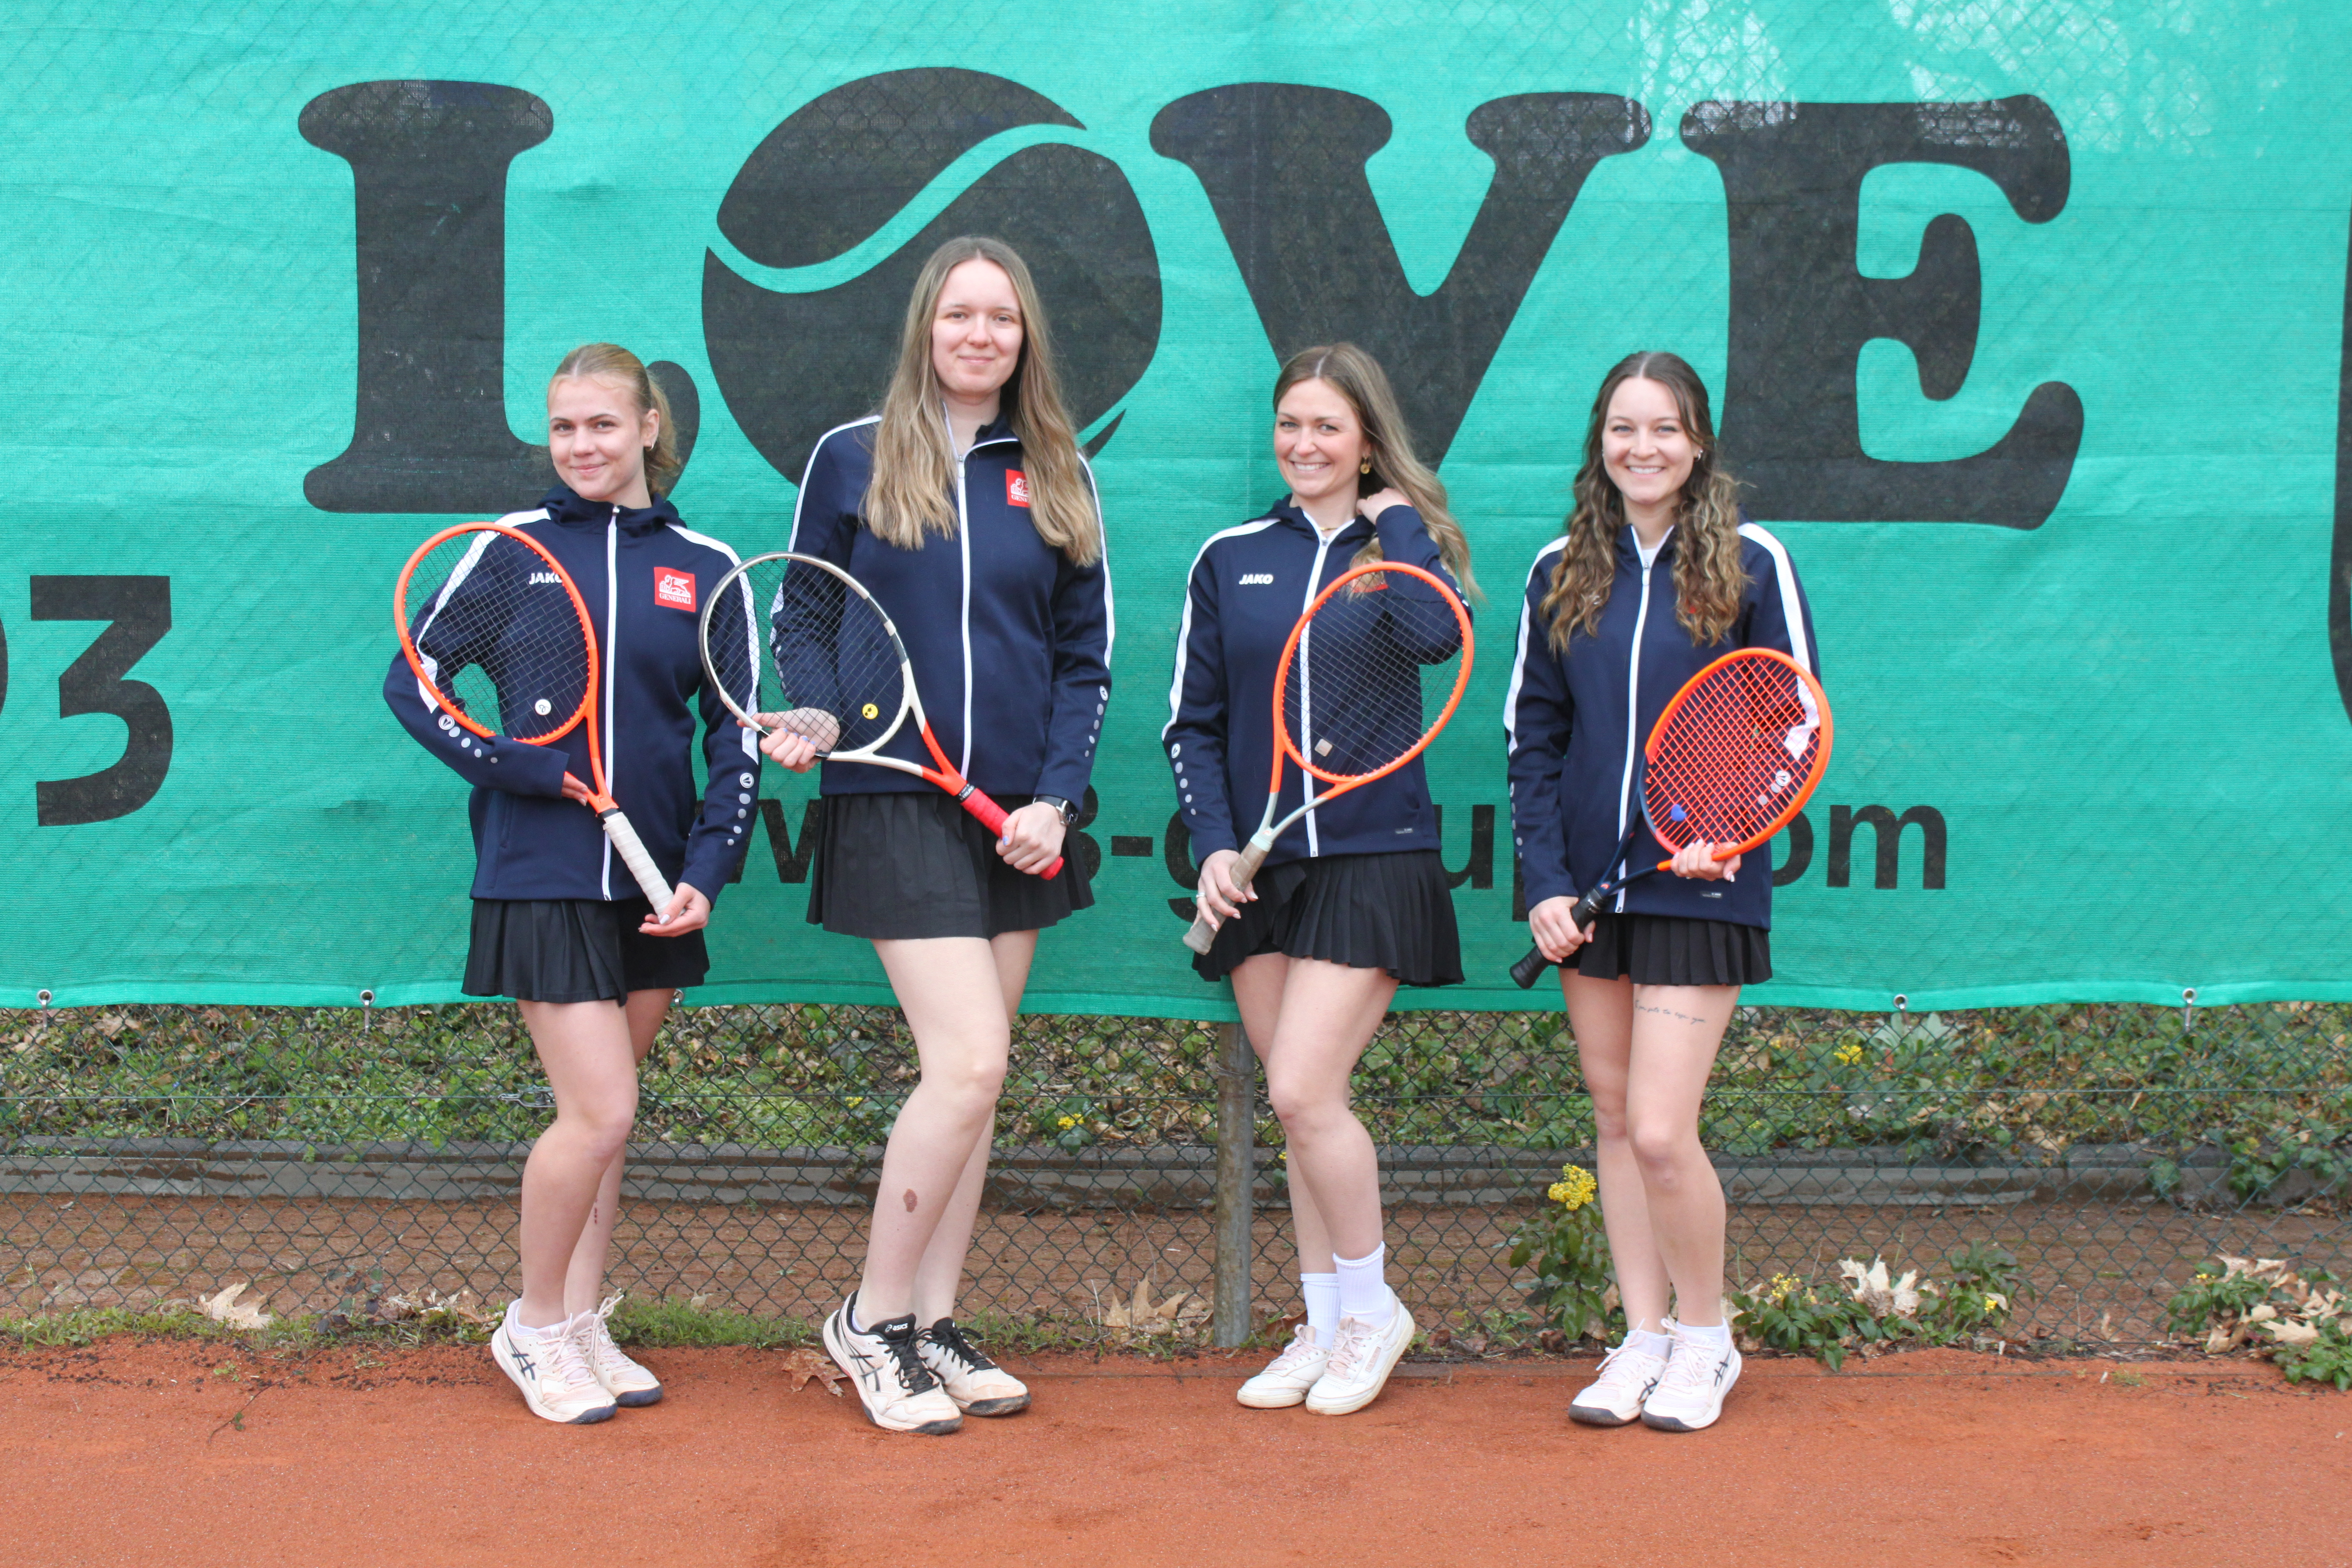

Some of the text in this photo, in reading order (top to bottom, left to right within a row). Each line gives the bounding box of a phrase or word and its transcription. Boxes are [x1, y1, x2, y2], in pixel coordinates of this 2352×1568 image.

[299, 67, 2085, 529] LOVE
[659, 592, 691, 604] GENERALI
[1238, 574, 1274, 585] JAKO
[0, 575, 173, 827] 3
